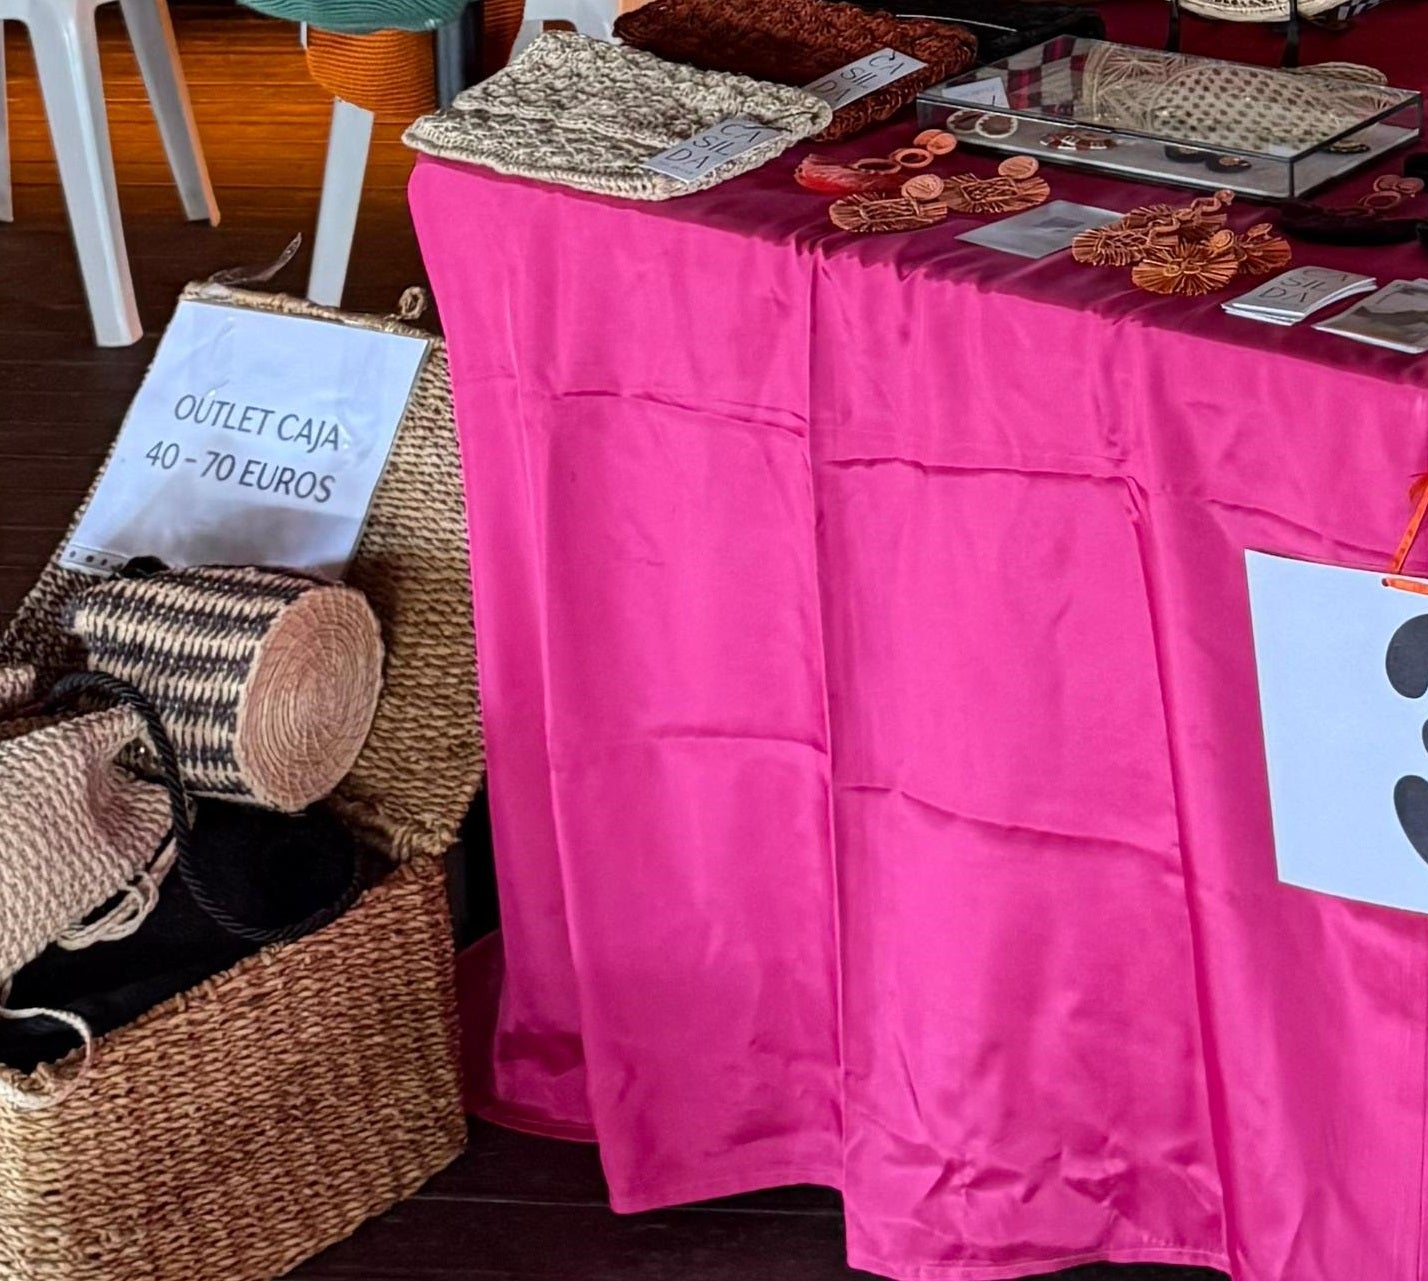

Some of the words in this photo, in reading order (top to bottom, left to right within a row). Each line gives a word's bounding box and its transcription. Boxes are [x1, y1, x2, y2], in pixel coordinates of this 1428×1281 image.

[840, 66, 877, 89] SIL
[692, 135, 735, 156] SIL
[665, 147, 709, 169] DA
[1258, 286, 1308, 303] DA
[174, 393, 275, 436] OUTLET
[276, 412, 340, 454] CAJA
[146, 440, 180, 470] 40
[199, 450, 237, 482] 70
[238, 458, 337, 504] EUROS
